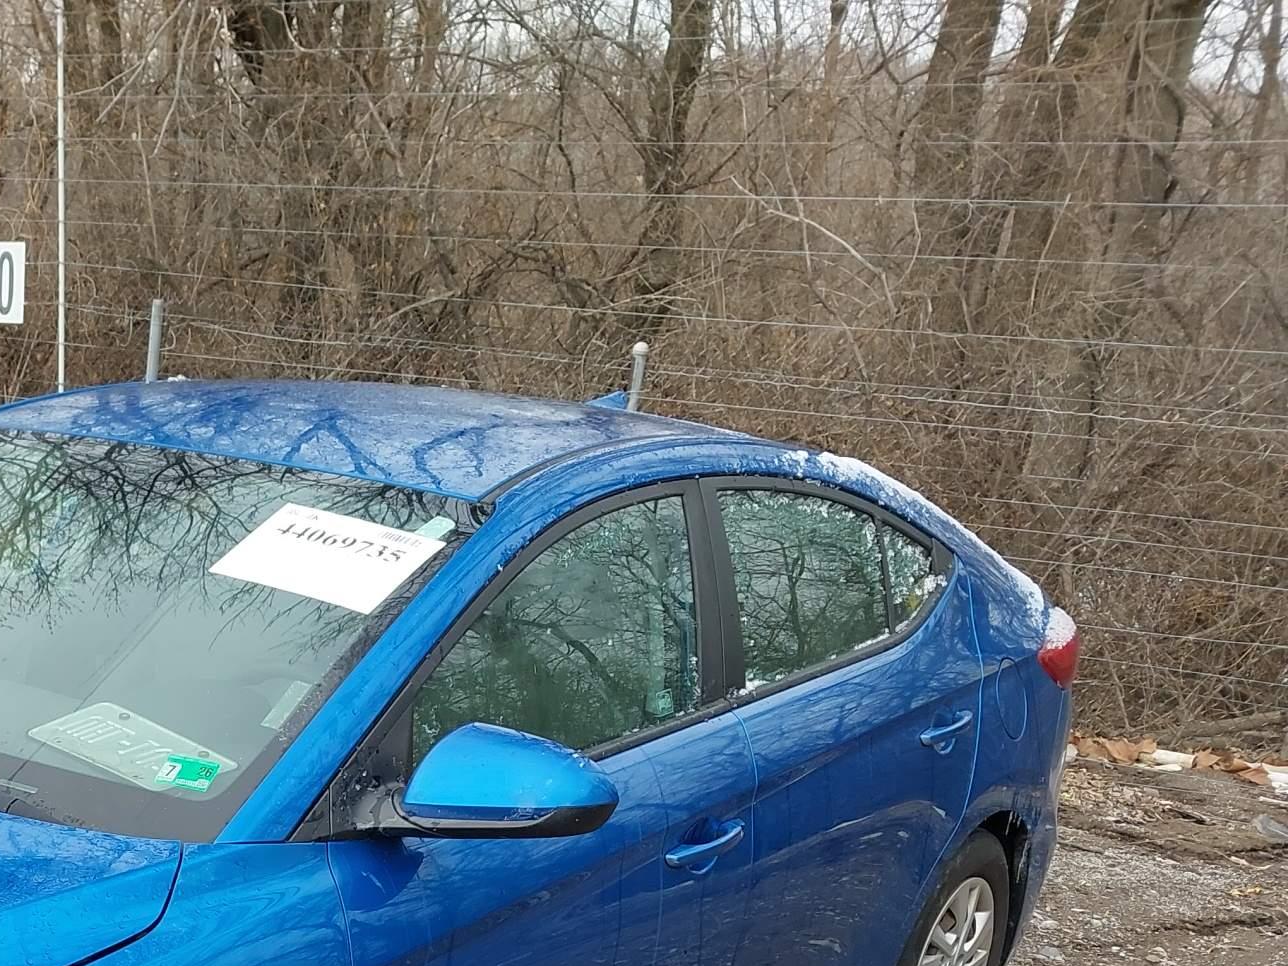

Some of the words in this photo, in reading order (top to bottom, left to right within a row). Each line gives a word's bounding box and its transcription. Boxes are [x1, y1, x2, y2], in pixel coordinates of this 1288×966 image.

[277, 523, 407, 562] 44069735
[165, 764, 177, 777] 7
[197, 766, 214, 778] 26
